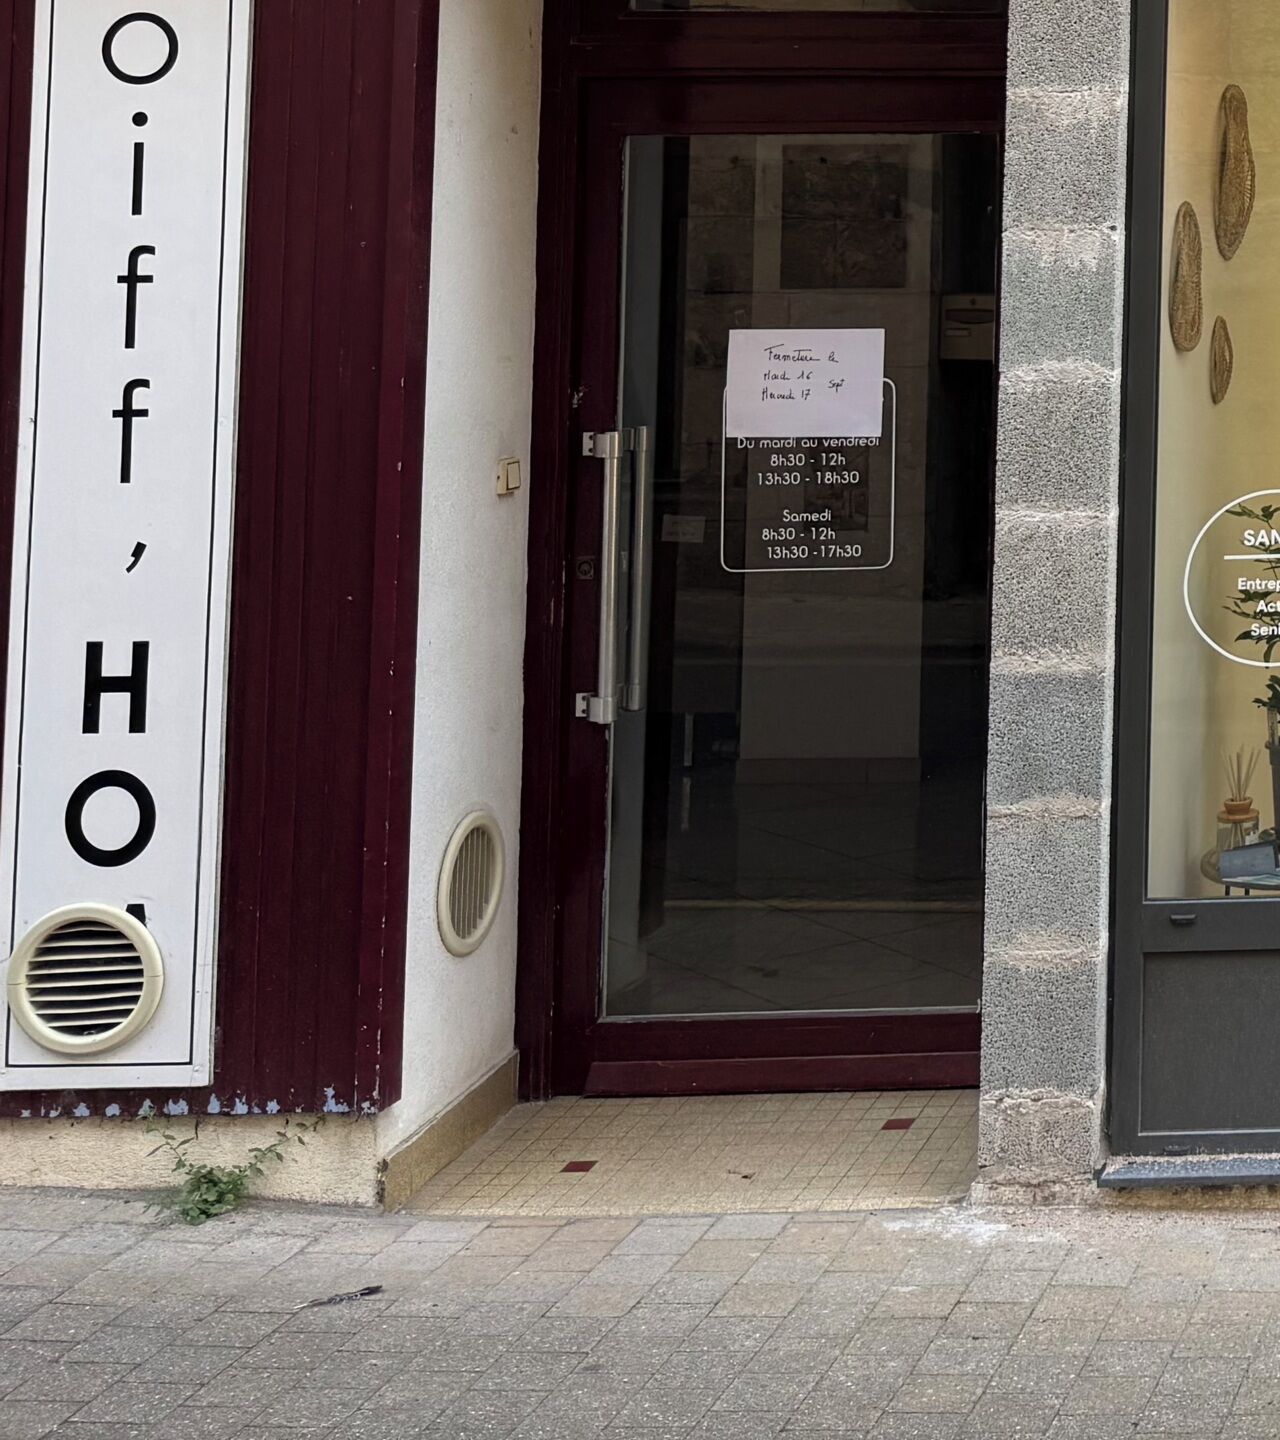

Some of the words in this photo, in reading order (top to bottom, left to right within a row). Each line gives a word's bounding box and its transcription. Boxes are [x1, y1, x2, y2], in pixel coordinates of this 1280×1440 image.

[797, 371, 813, 380] 16
[801, 389, 811, 401] 17
[737, 437, 755, 449] Du
[759, 437, 797, 448] mardi
[801, 439, 818, 448] au
[823, 437, 880, 447] vendredi
[770, 454, 805, 466] 8h30
[821, 454, 846, 466] 12h
[757, 473, 800, 485] 13h30
[816, 471, 860, 484] 18h30
[783, 509, 832, 522] Samedi
[762, 528, 796, 540] 8h30
[811, 527, 836, 540] 12h
[767, 546, 808, 558] 13h30
[820, 544, 862, 557] 17h30
